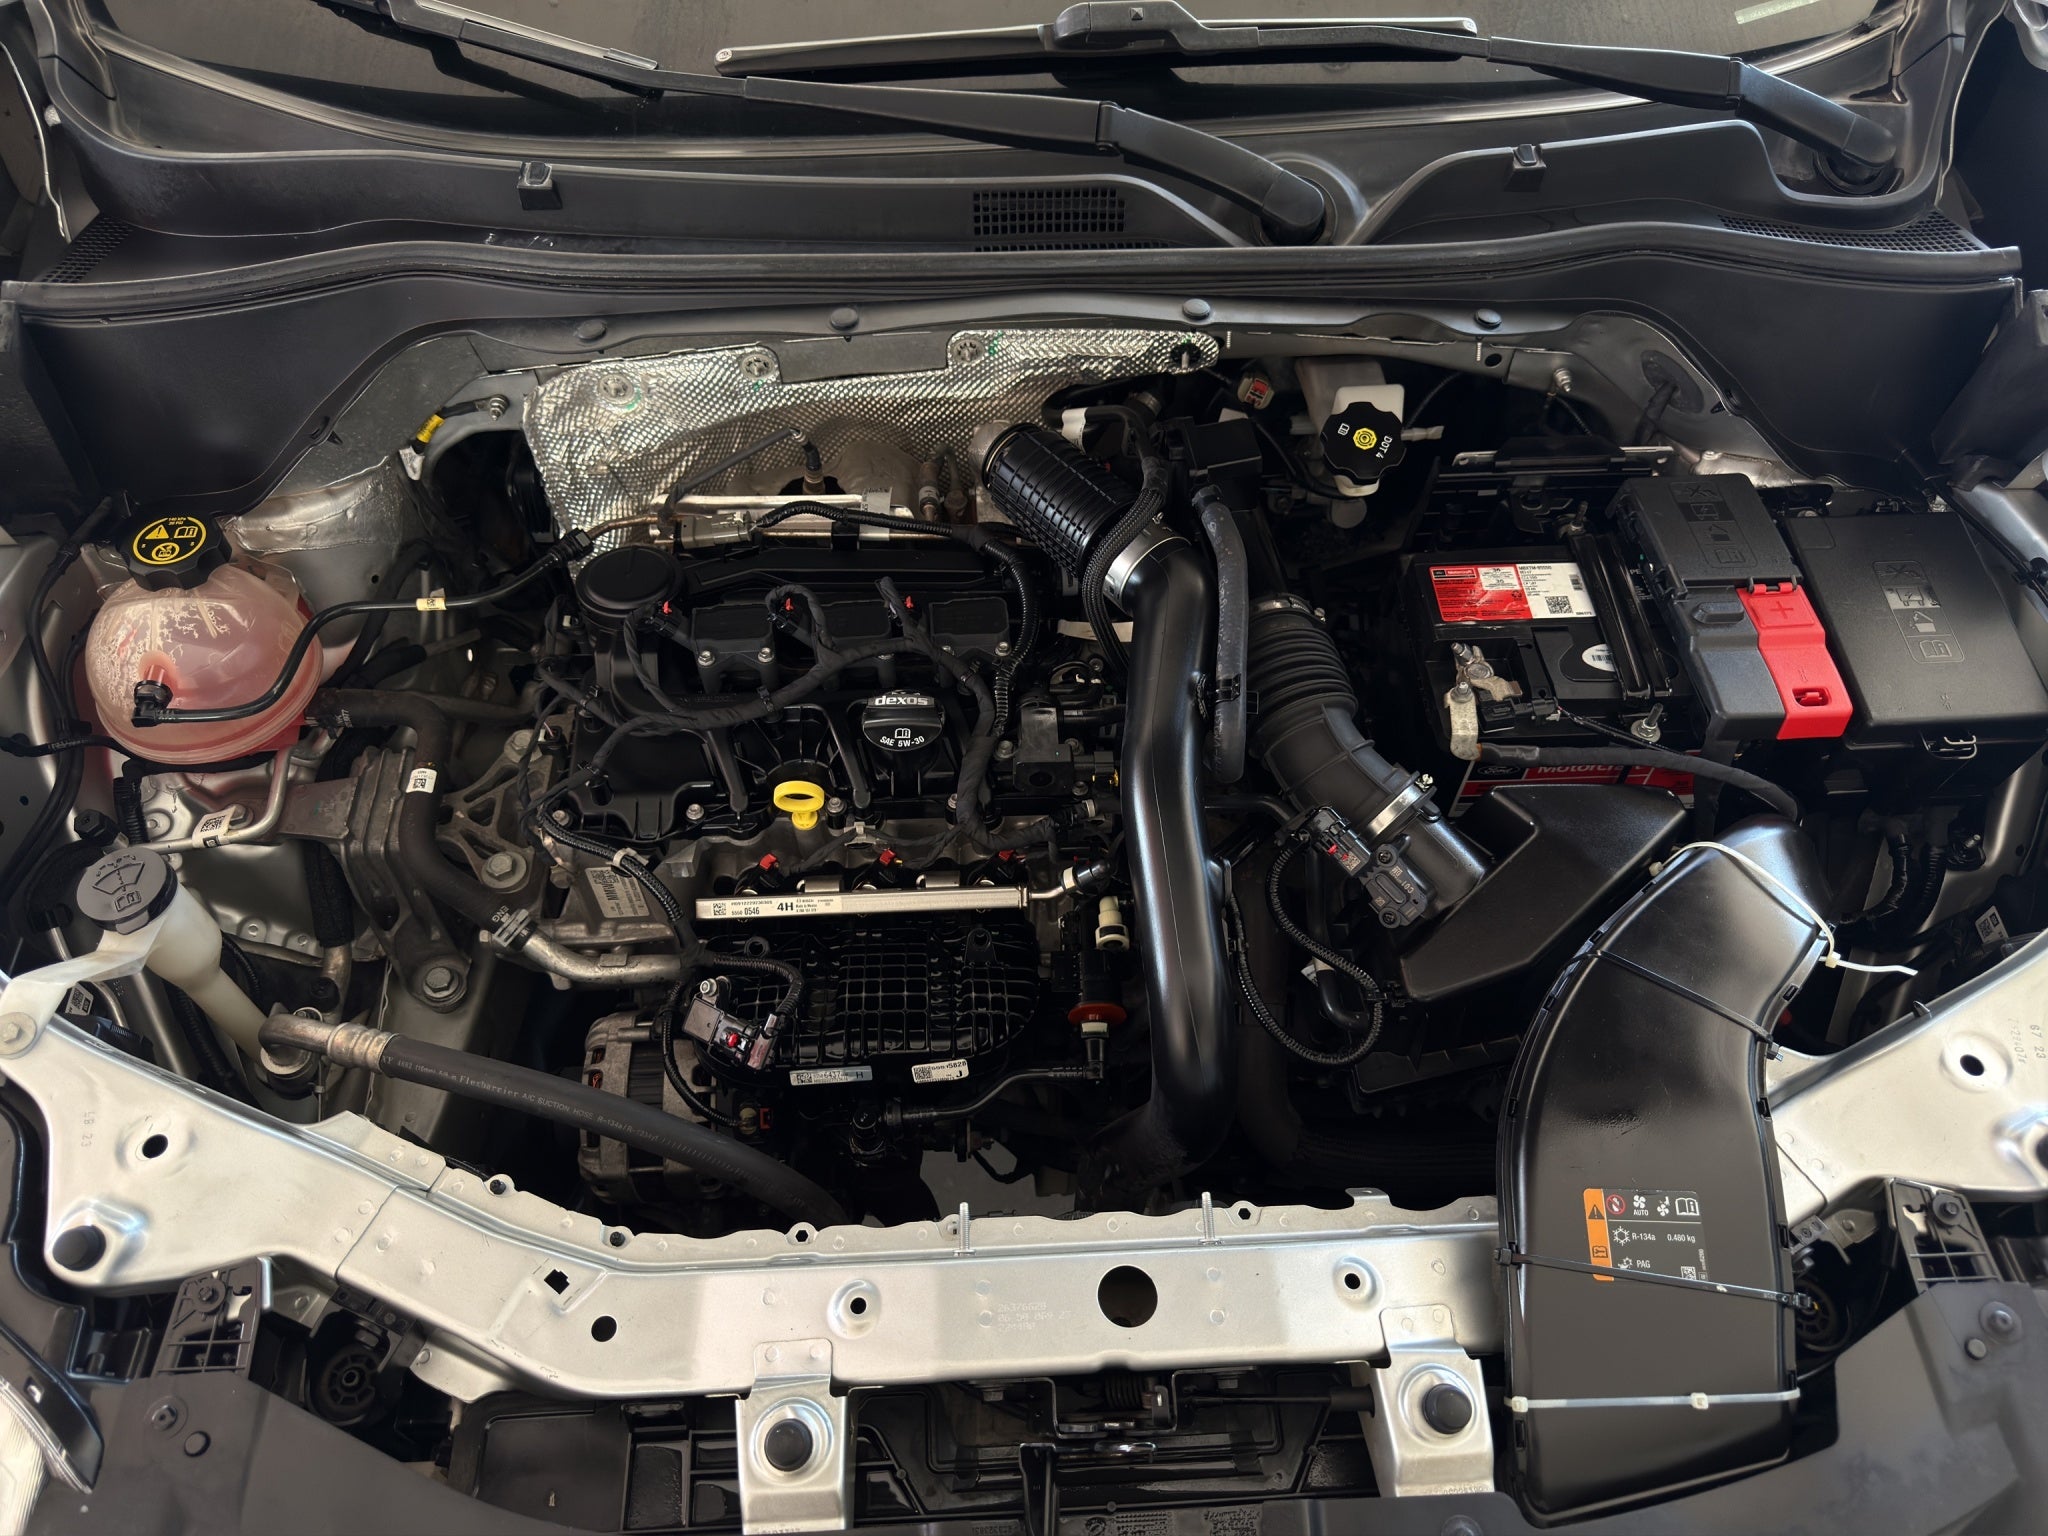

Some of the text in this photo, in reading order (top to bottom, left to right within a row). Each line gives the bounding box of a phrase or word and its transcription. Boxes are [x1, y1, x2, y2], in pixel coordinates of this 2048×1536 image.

[1379, 435, 1393, 453] DOT
[874, 695, 928, 706] dexos
[879, 735, 925, 747] SAE 5W-30
[744, 907, 760, 916] 0546
[776, 902, 794, 911] 4H
[491, 905, 509, 923] ENG
[855, 1071, 864, 1079] H
[955, 1070, 963, 1078] J
[459, 1074, 521, 1098] Flexbarrier
[522, 1092, 536, 1102] A/C
[537, 1096, 571, 1113] SUCTION
[573, 1108, 594, 1120] HOSE
[1631, 1232, 1656, 1241] R-134a
[1687, 1234, 1696, 1243] kg
[1636, 1259, 1651, 1269] PAG
